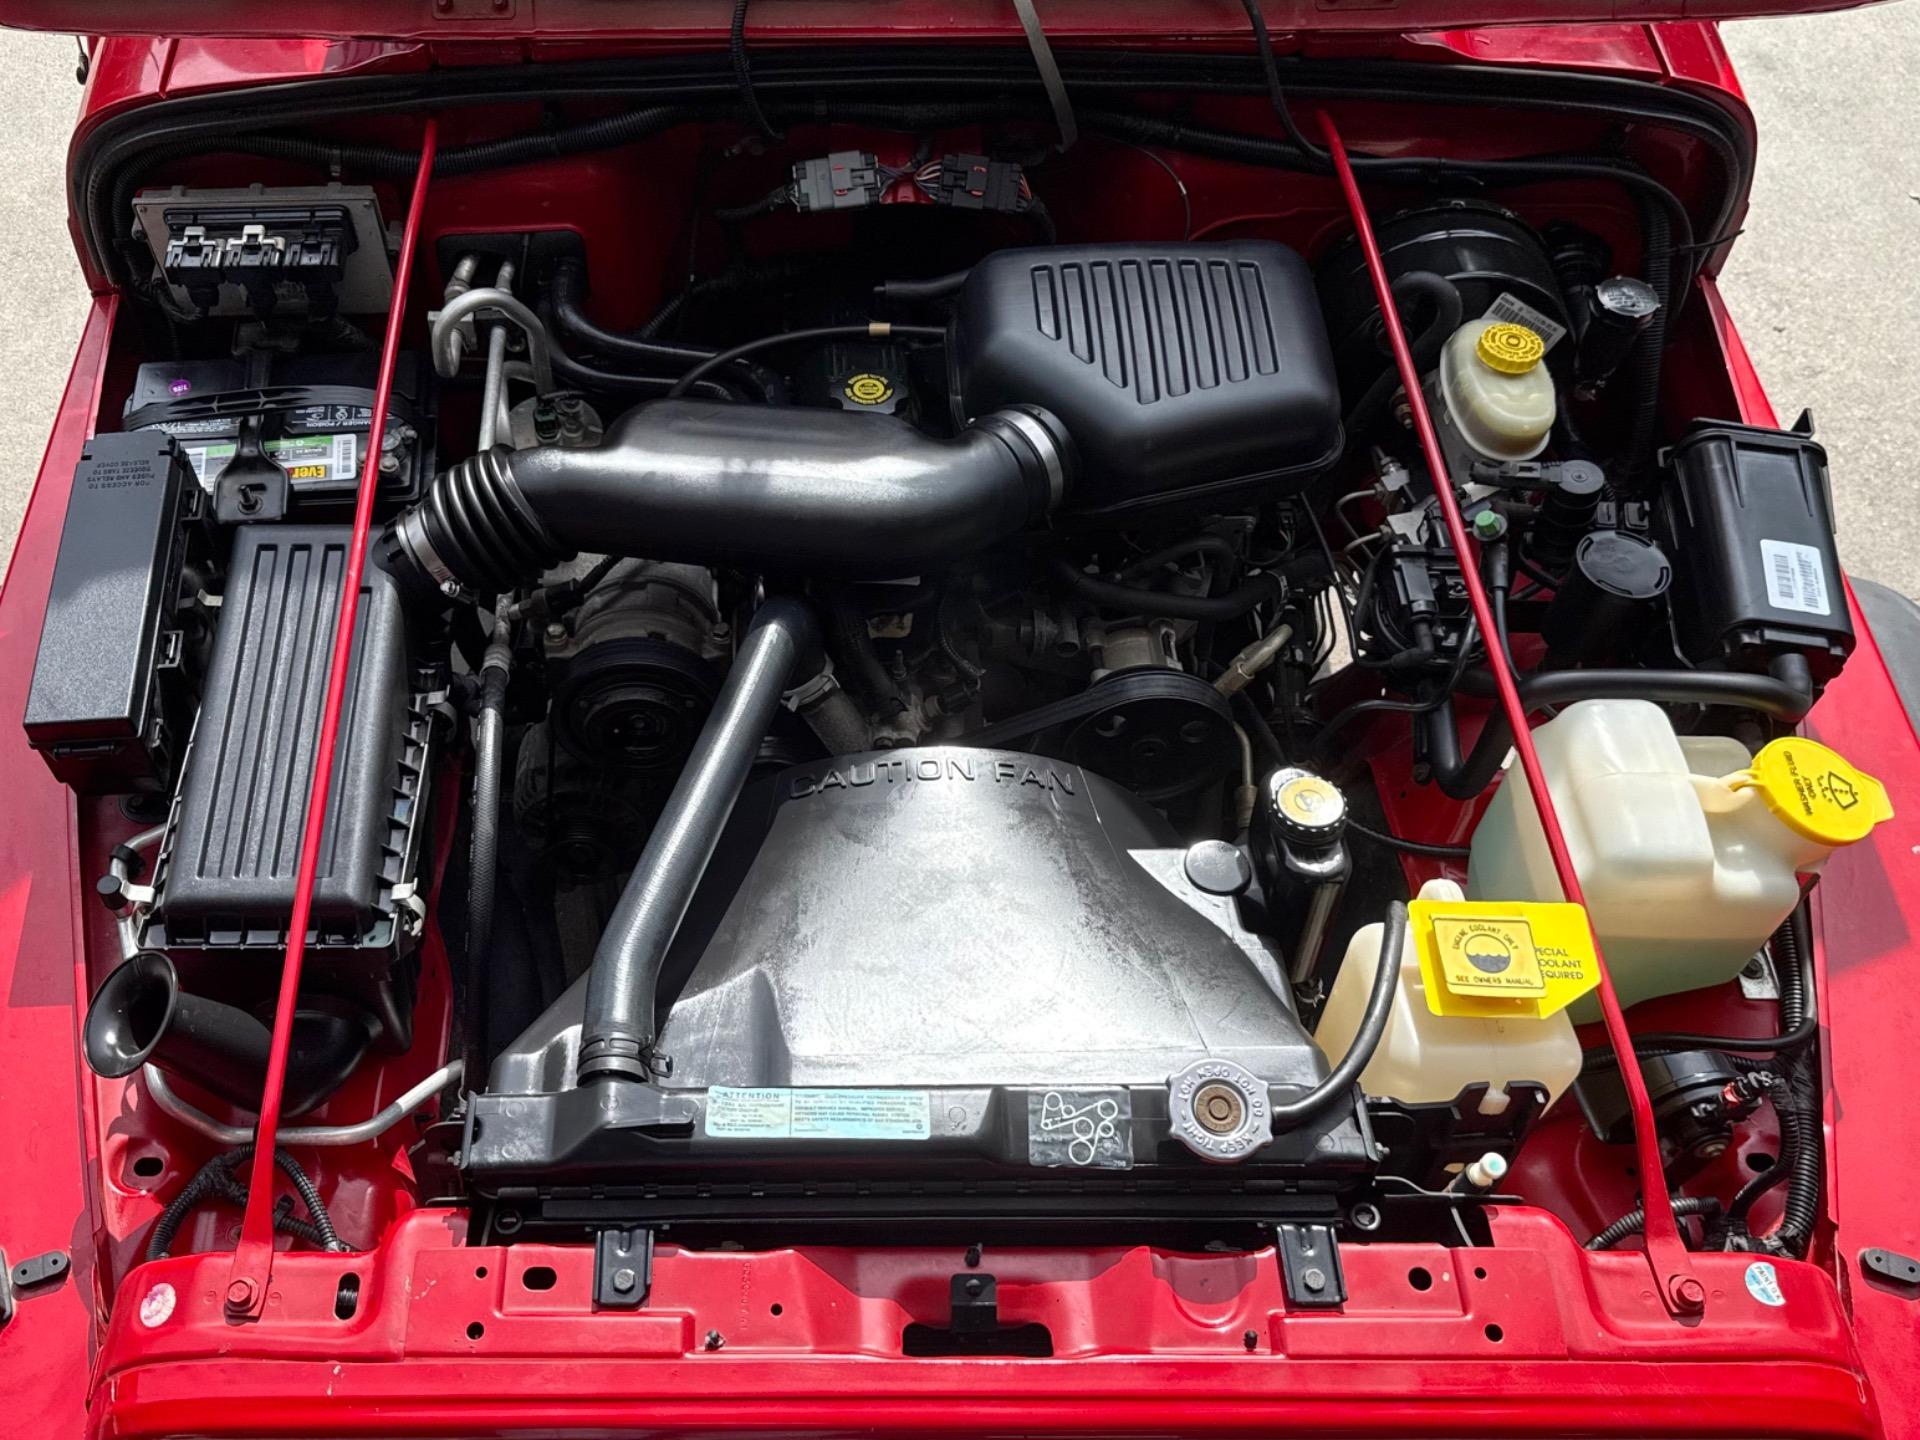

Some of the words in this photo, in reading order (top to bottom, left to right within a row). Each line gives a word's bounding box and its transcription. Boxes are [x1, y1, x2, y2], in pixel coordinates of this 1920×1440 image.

[86, 475, 115, 483] RELAYS
[291, 465, 326, 480] Ever
[100, 481, 133, 489] ACCESS
[1783, 750, 1799, 777] FLUID
[789, 759, 976, 799] CAUTION
[994, 761, 1075, 796] FAN
[1801, 775, 1817, 800] ONLY
[1793, 779, 1813, 816] WASHER
[1452, 929, 1469, 950] ENGINE
[1469, 924, 1502, 935] COOLANT
[1503, 932, 1519, 951] ONLY
[1535, 947, 1569, 957] PECIAL
[1538, 959, 1582, 968] OOLANT
[1455, 974, 1470, 983] SEE
[1472, 975, 1502, 985] OWNERS
[1505, 977, 1534, 986] MANUAL
[1541, 970, 1584, 980] EQUIRED
[1196, 1065, 1231, 1080] OPEN
[721, 1091, 781, 1100] ATTENTION
[1177, 1075, 1194, 1102] HOT
[1252, 1099, 1265, 1118] DO
[1182, 1120, 1215, 1152] TIGHT
[1219, 1133, 1254, 1154] KEEP
[1754, 1265, 1773, 1286] PAINT
